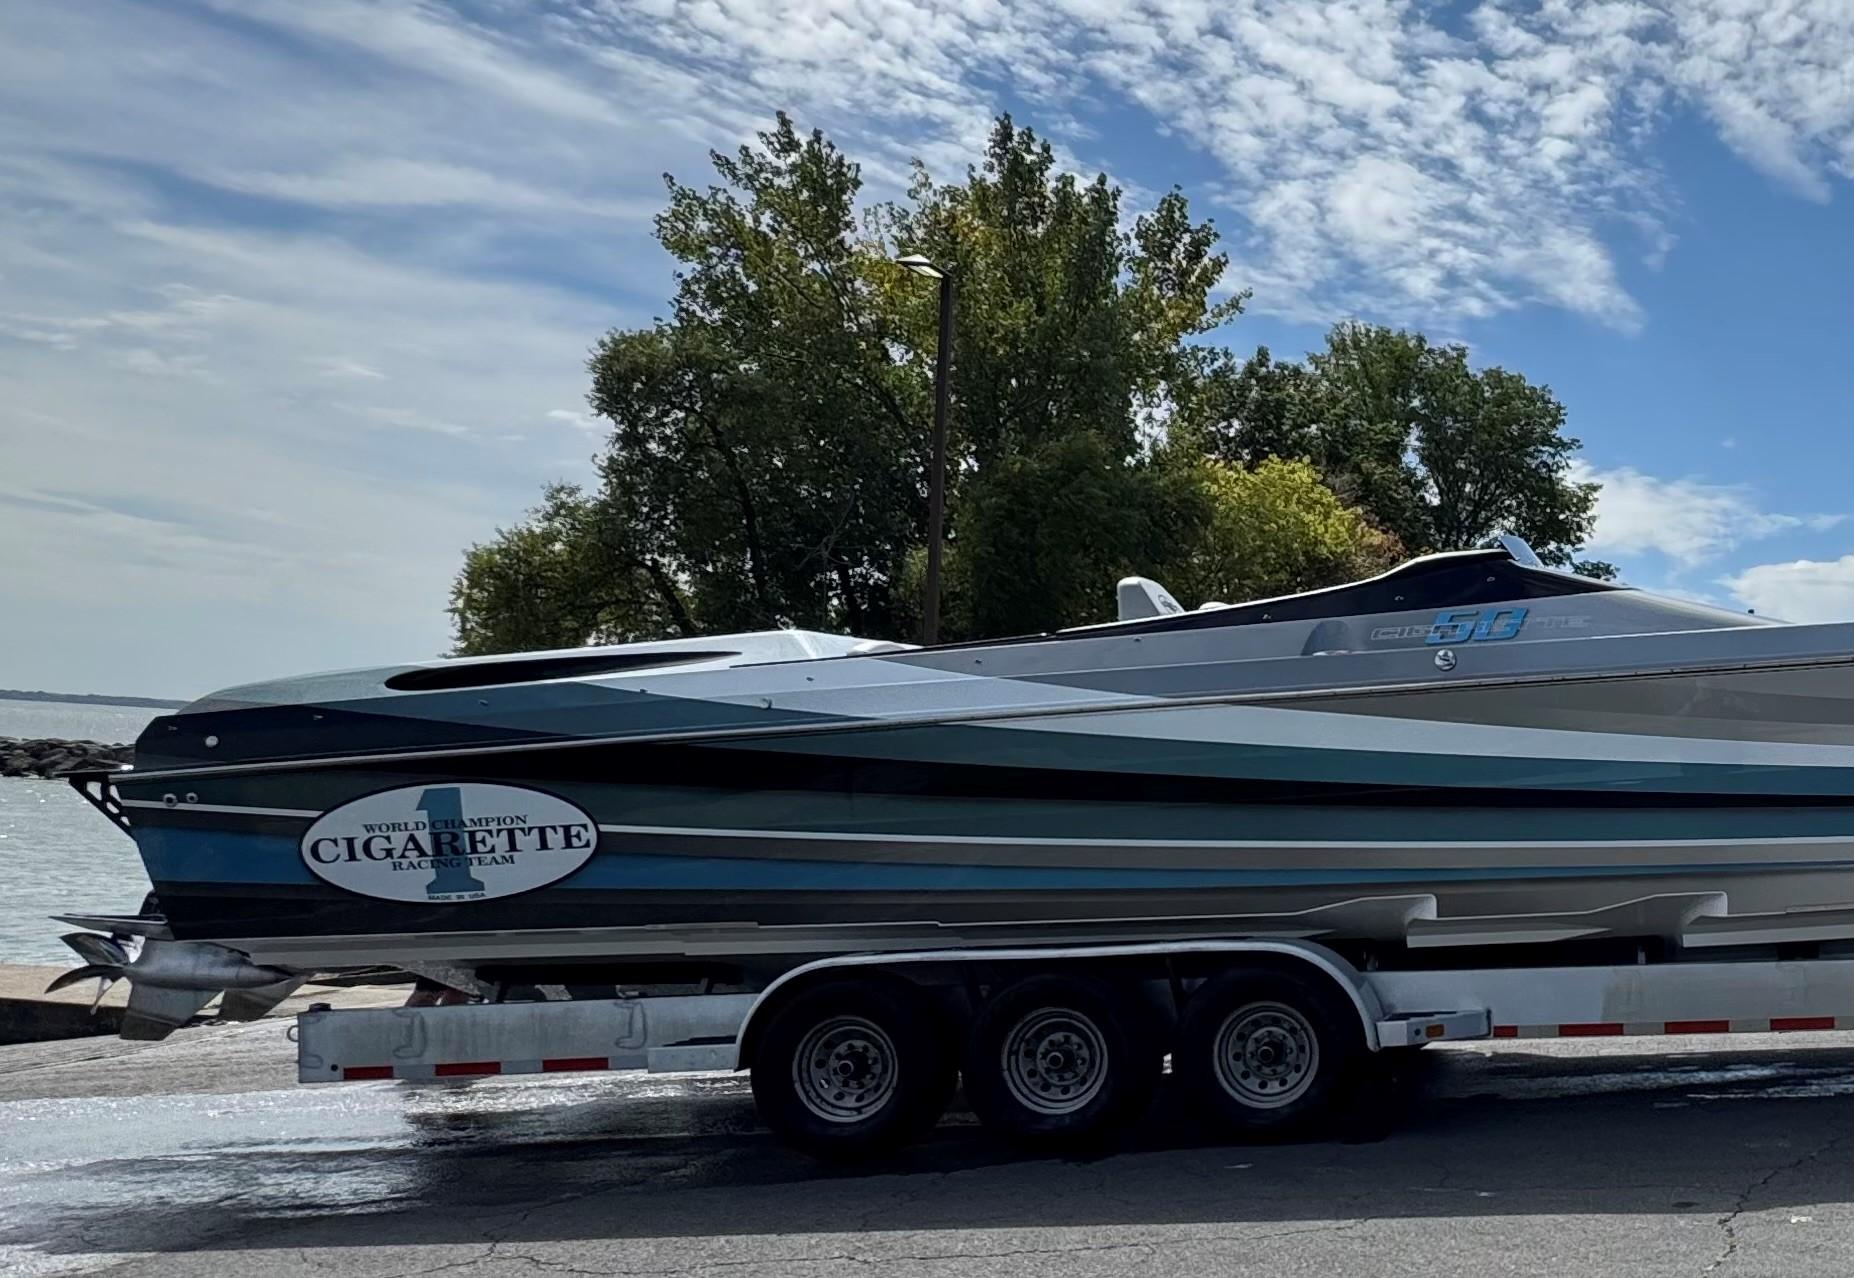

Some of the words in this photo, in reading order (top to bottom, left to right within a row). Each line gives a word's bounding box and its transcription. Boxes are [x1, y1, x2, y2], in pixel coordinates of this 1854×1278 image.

[1425, 608, 1529, 645] 50
[364, 823, 427, 834] WORLD
[431, 815, 528, 830] CHAMPION
[416, 787, 485, 893] 1
[310, 823, 591, 864] CIGARETTE
[392, 858, 462, 871] RACING
[468, 854, 516, 866] TEAM
